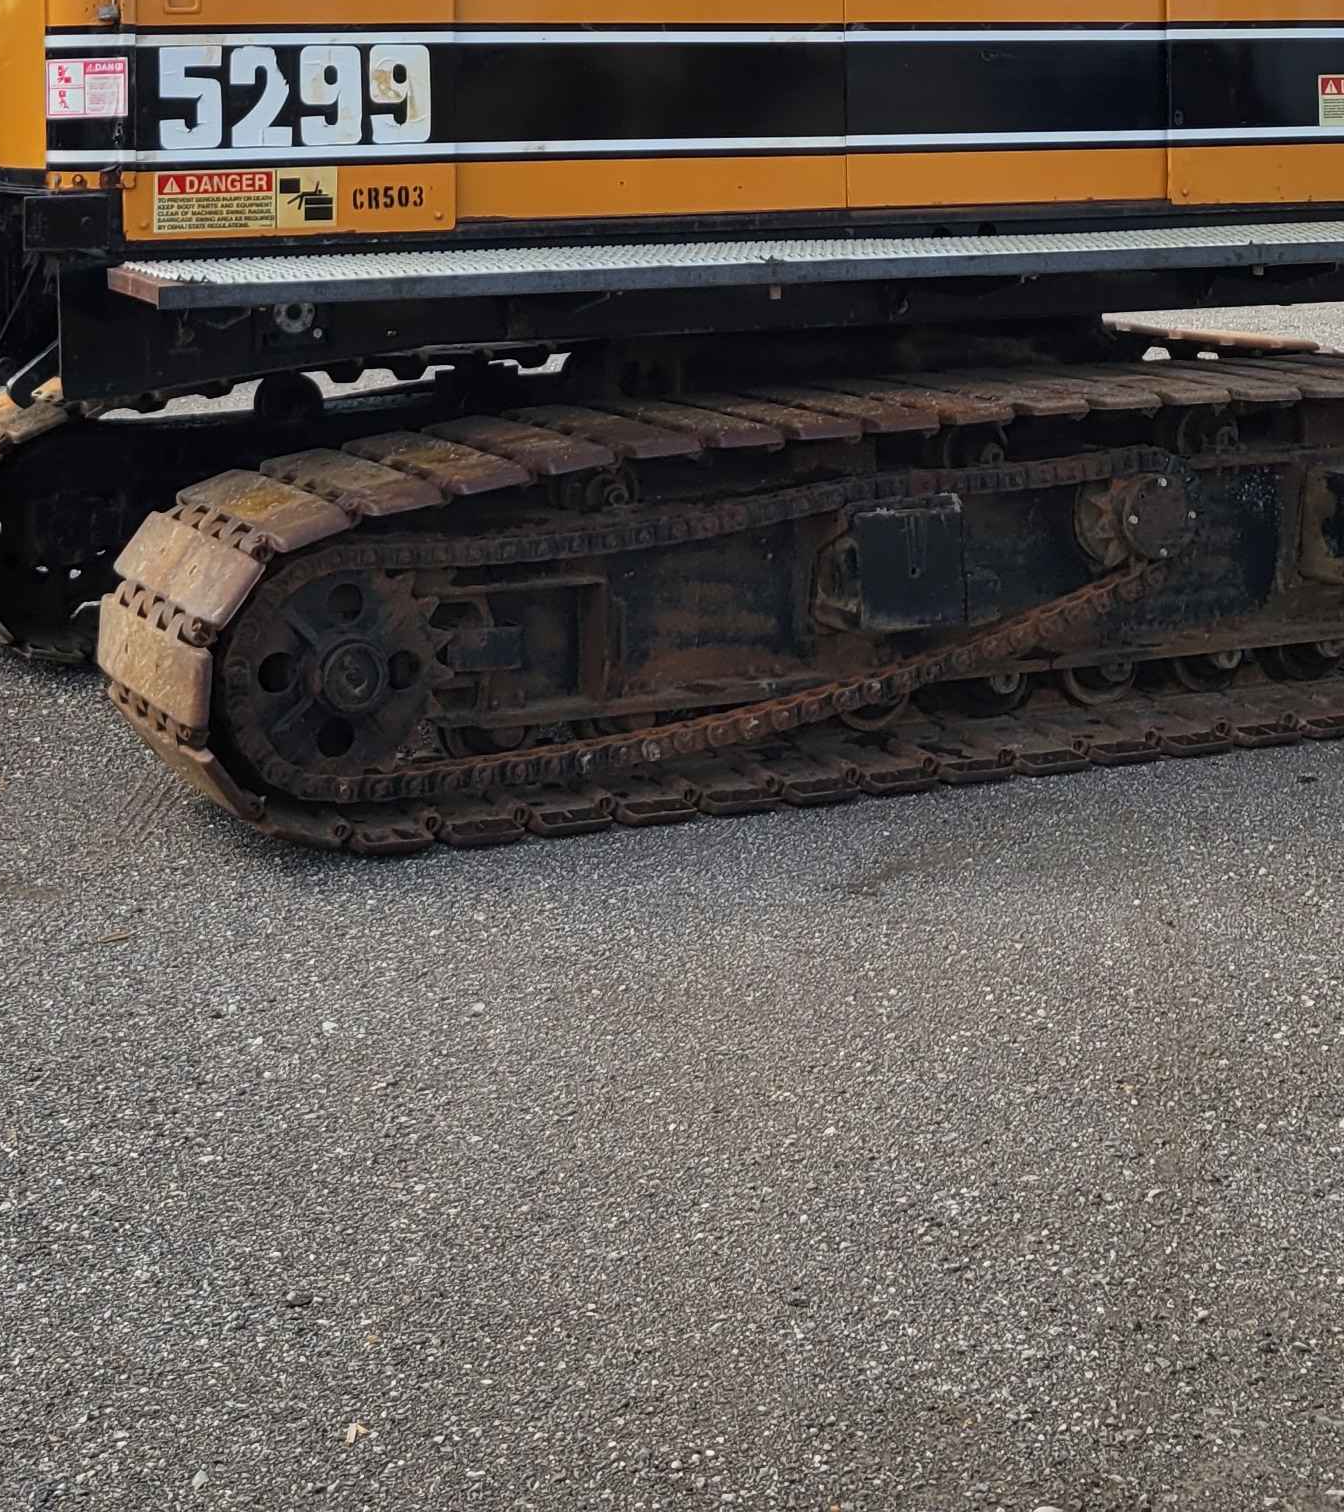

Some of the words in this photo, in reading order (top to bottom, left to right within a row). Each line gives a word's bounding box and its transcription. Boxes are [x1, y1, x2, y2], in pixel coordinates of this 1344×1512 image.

[159, 44, 431, 149] 5299
[185, 174, 267, 193] DANGER
[352, 185, 424, 209] CR503
